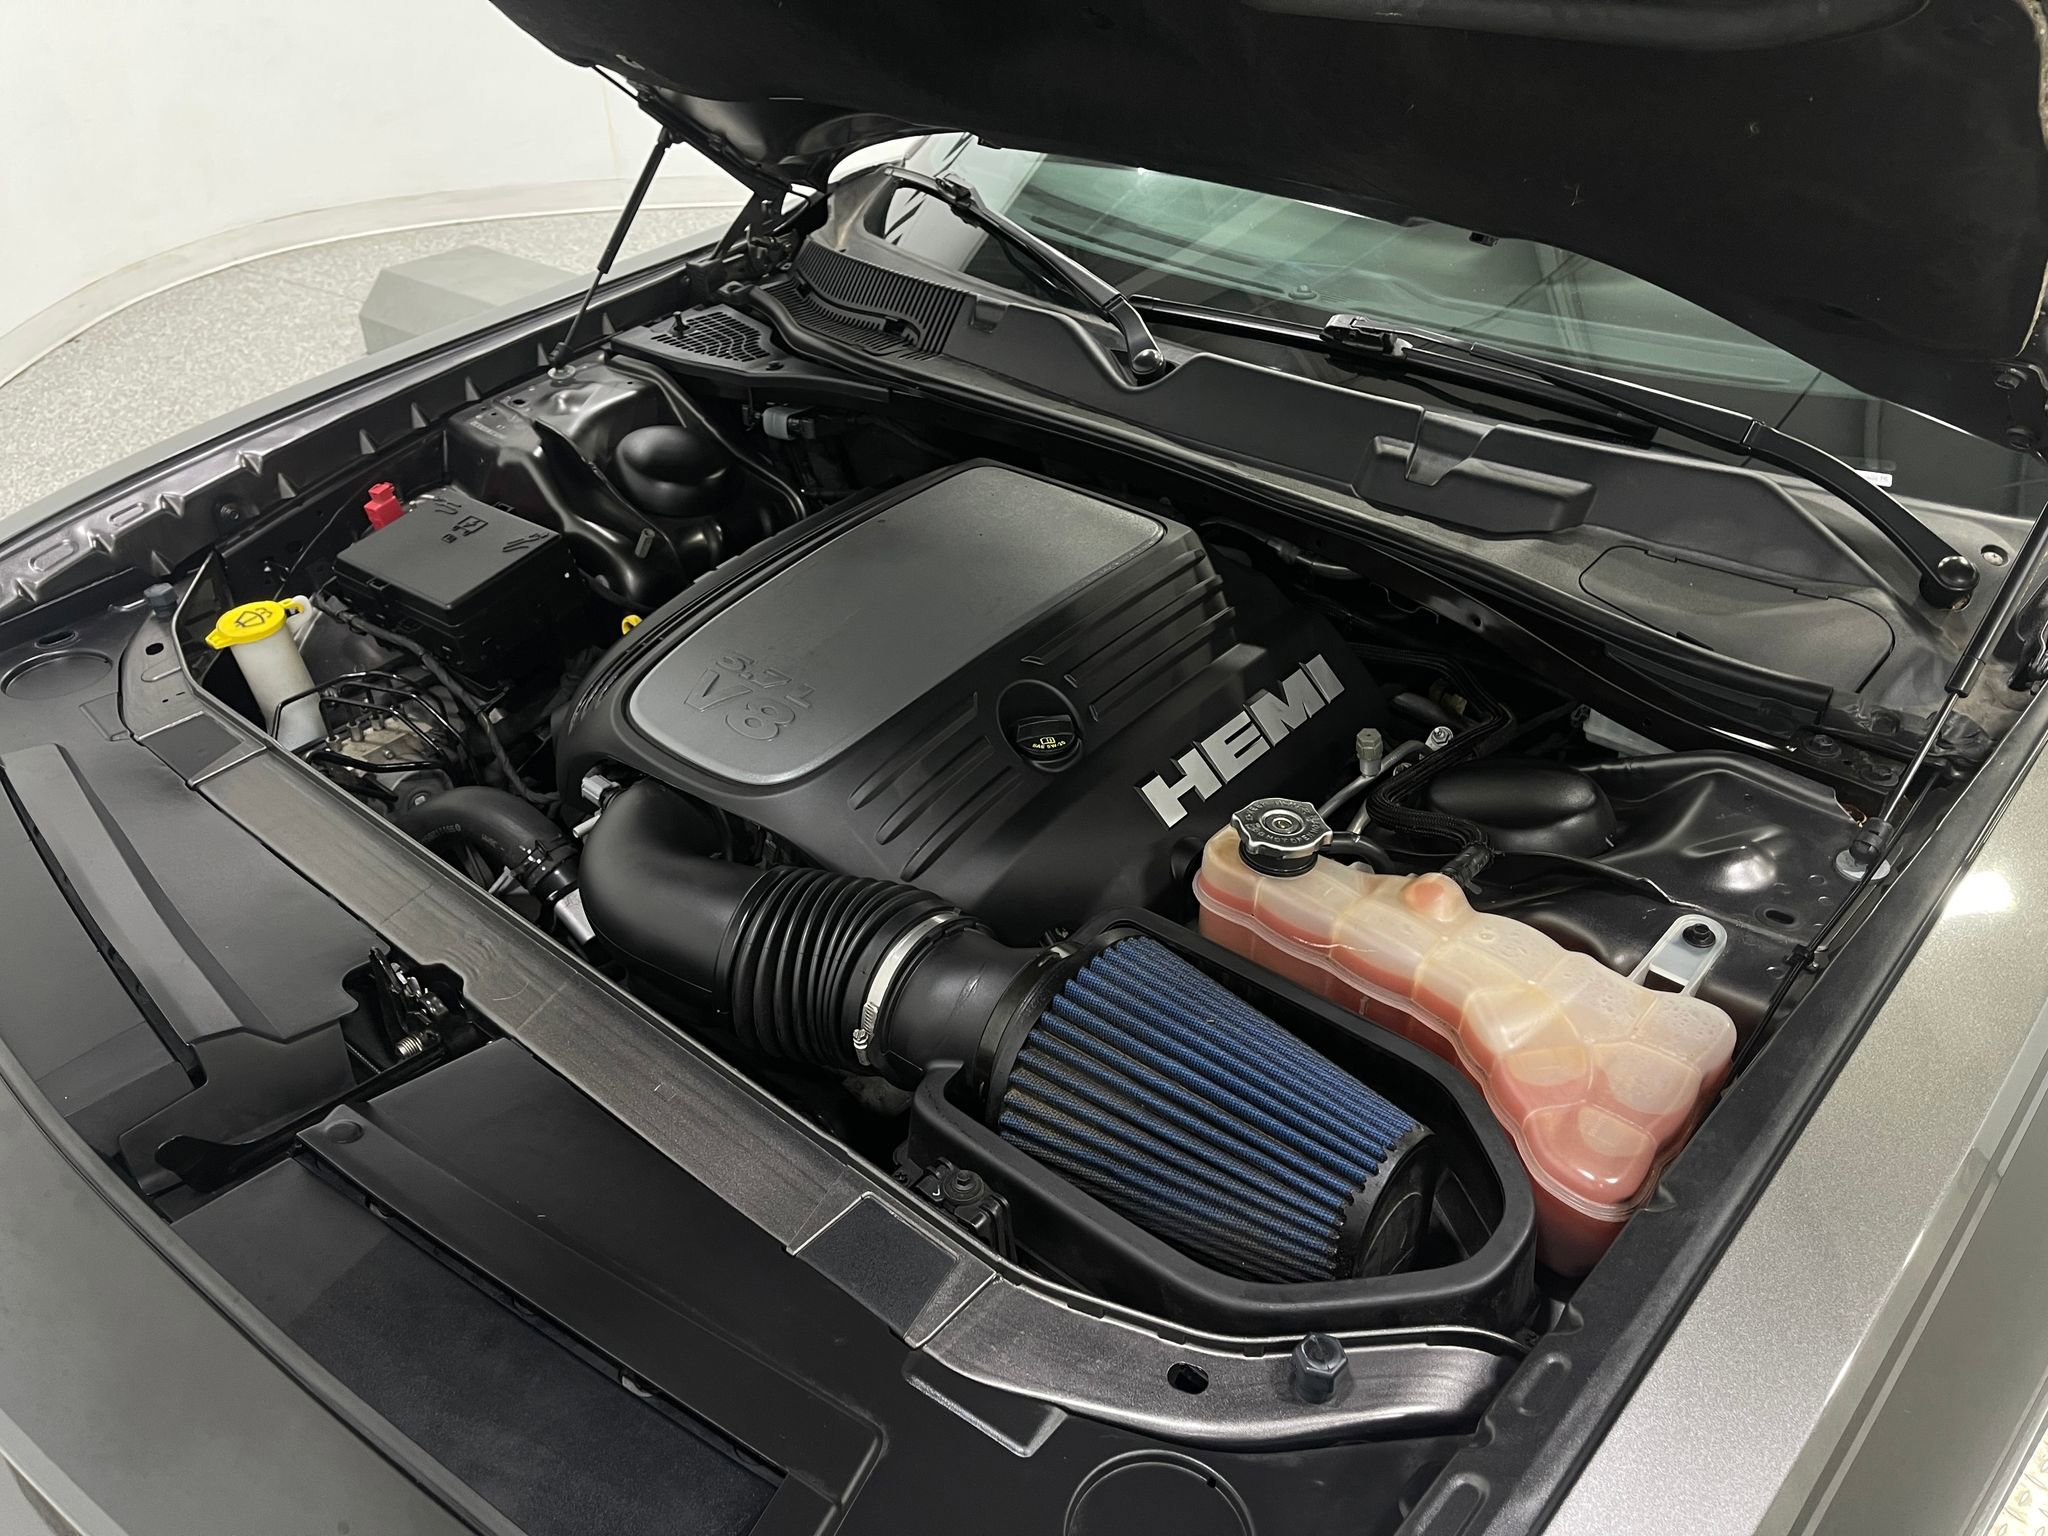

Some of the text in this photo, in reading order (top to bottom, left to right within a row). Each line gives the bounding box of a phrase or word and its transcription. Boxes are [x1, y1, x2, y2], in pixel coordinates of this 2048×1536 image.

[684, 668, 796, 741] V8
[716, 651, 816, 709] 5.7L
[1135, 653, 1345, 831] HEMI
